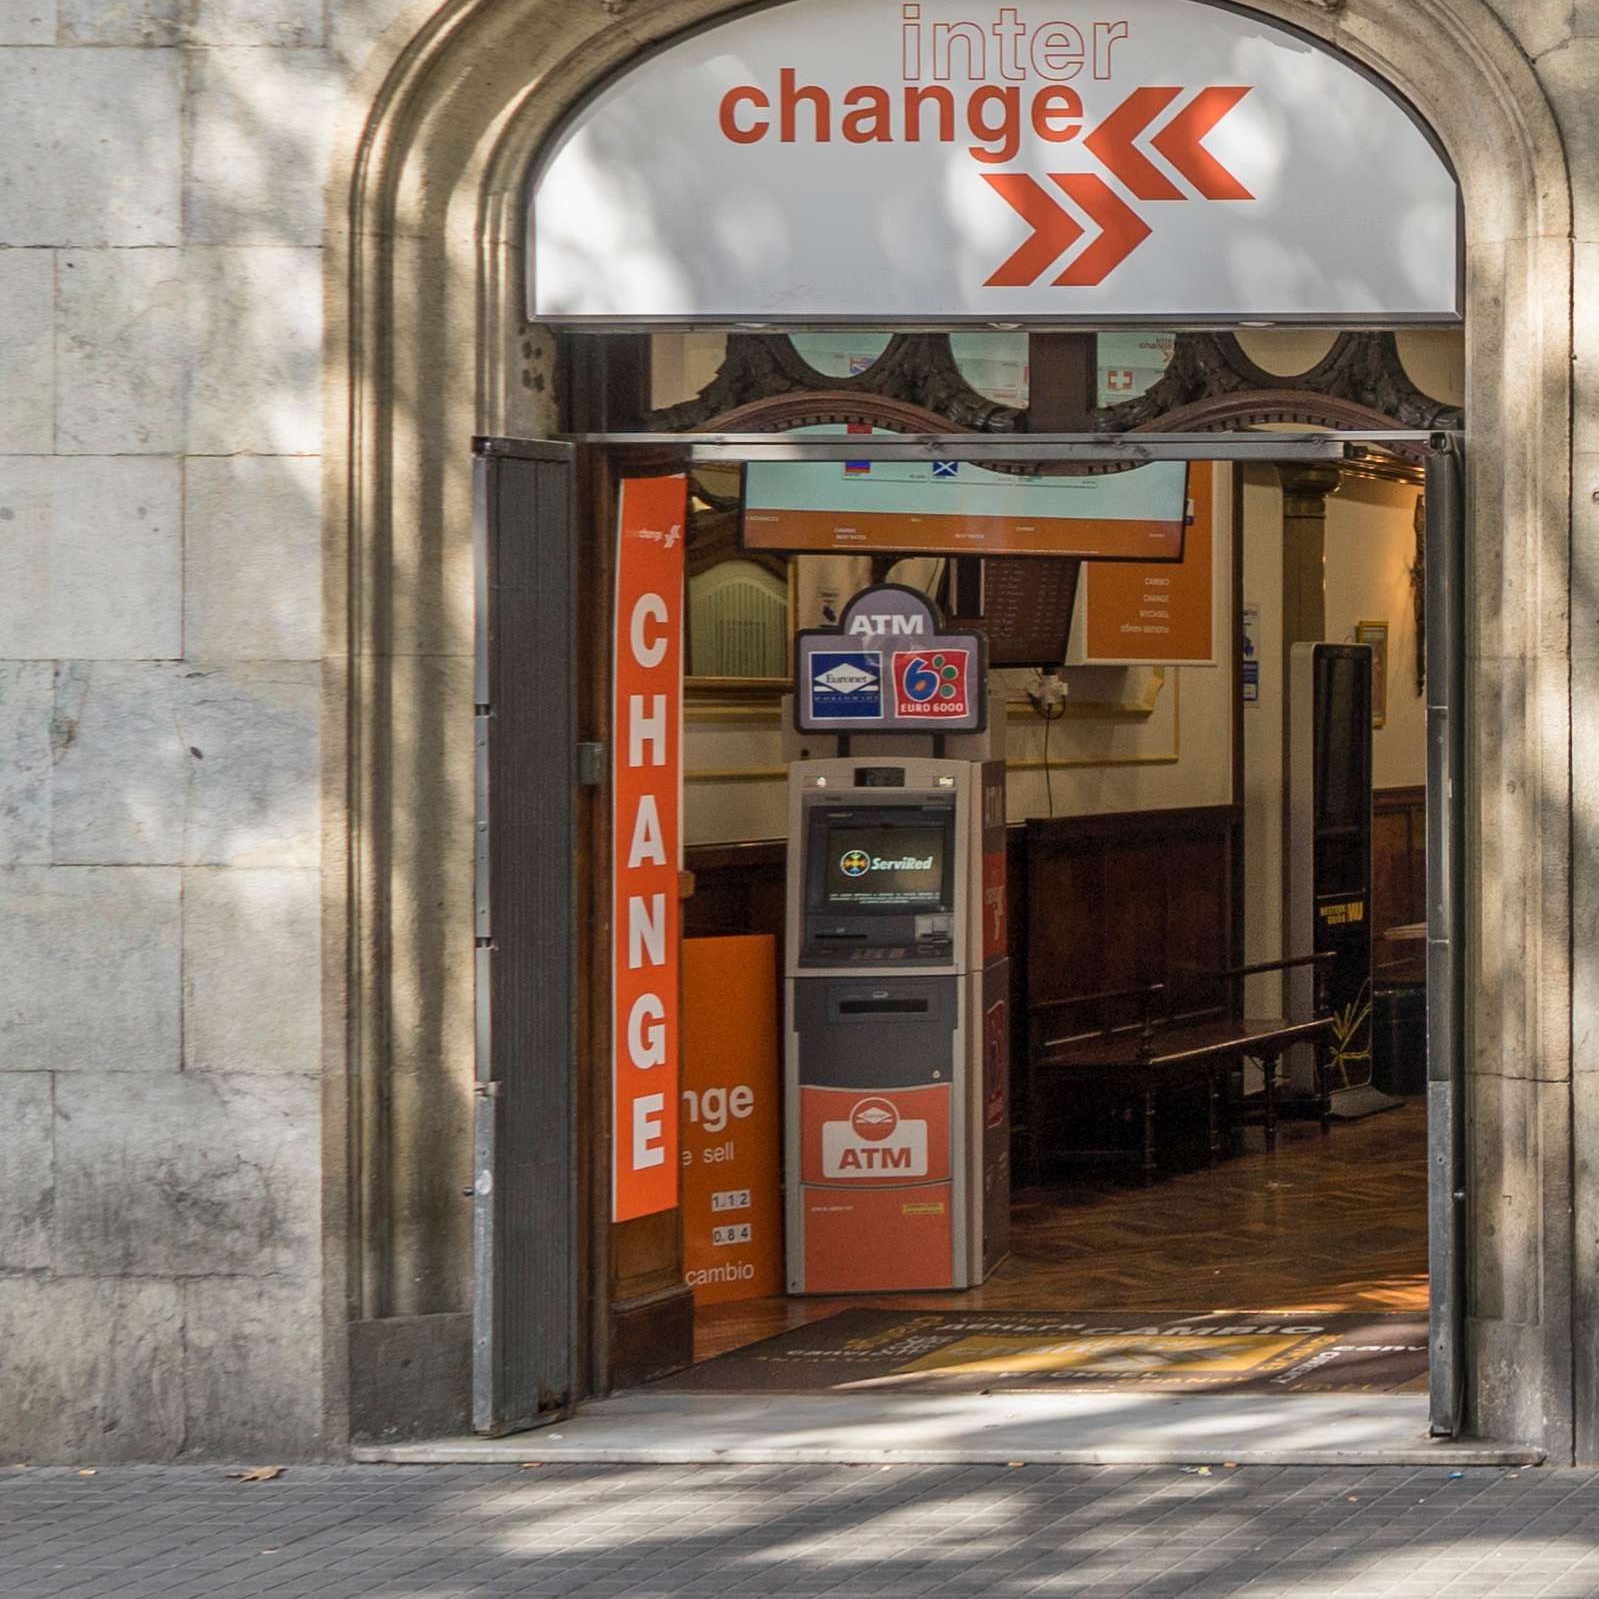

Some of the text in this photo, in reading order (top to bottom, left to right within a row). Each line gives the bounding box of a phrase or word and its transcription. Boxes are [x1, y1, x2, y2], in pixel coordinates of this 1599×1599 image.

[902, 3, 1130, 82] inter
[718, 67, 1084, 165] change
[849, 615, 924, 635] ATM
[825, 673, 868, 683] Euronet
[901, 703, 963, 712] EURO 6000
[871, 857, 933, 870] ServiRed
[627, 593, 669, 1171] CHANGE
[703, 1141, 734, 1163] sell
[839, 1148, 911, 1170] ATM
[685, 1262, 754, 1286] cambio
[1080, 1325, 1325, 1336] CAMBIO
